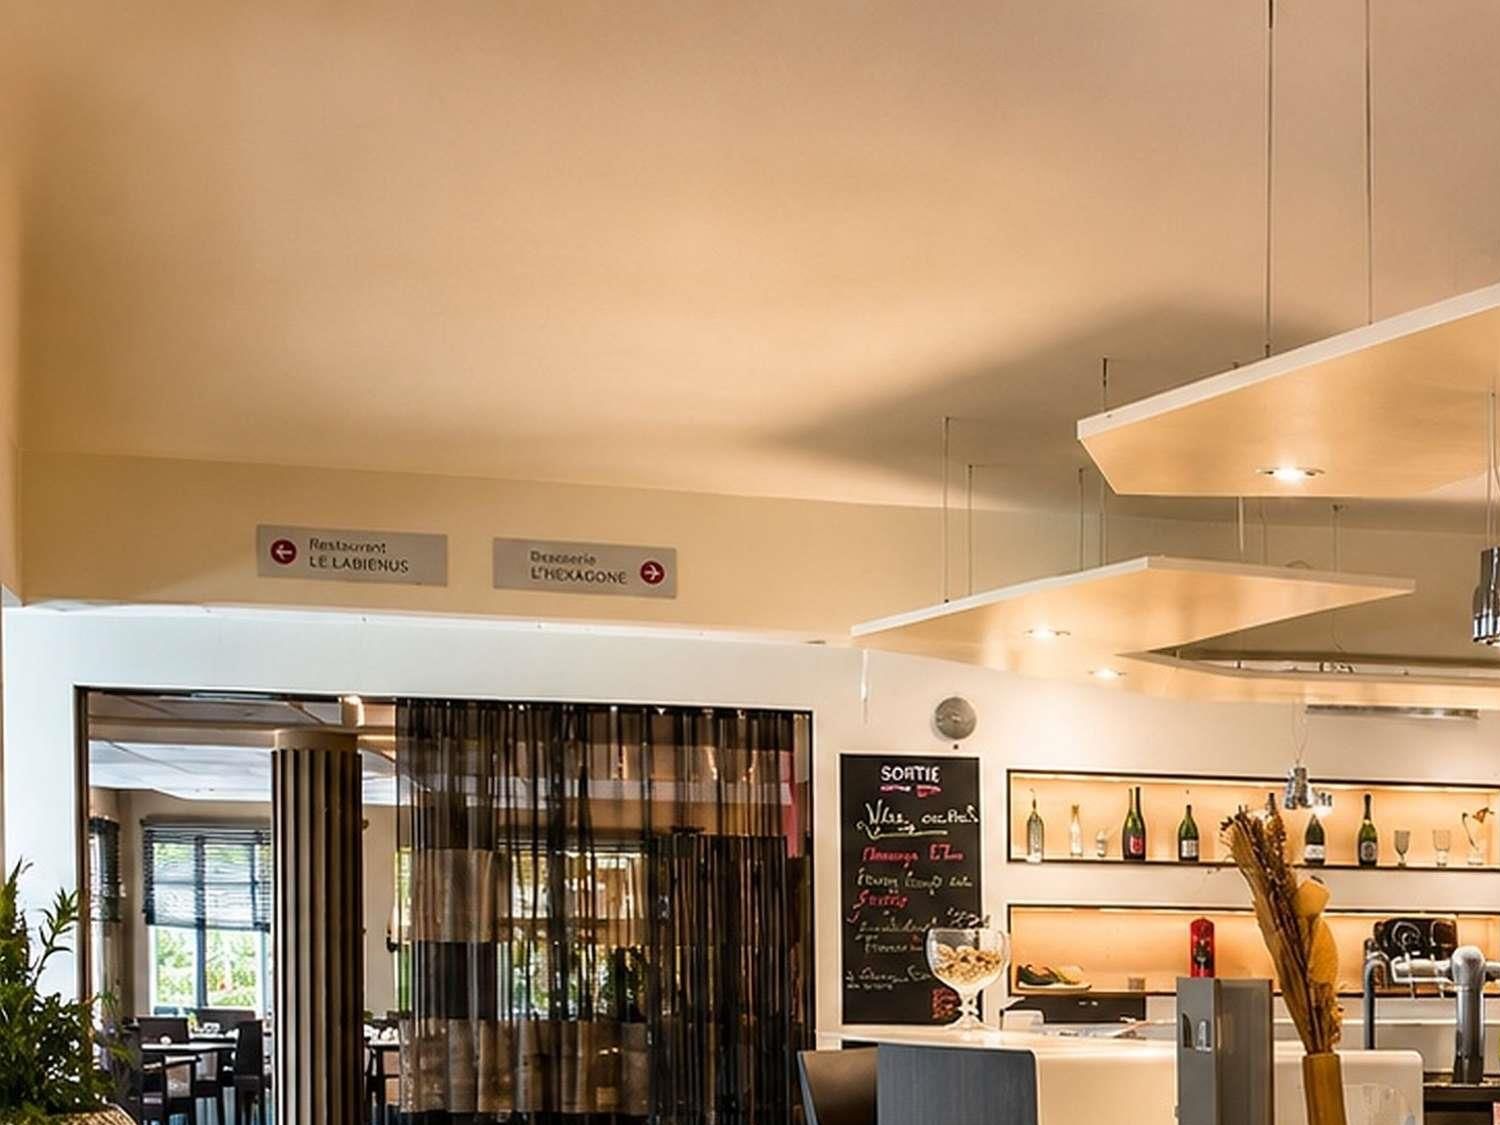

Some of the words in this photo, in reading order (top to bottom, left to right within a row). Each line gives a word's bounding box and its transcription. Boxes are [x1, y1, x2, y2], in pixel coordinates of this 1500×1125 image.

[309, 538, 386, 554] Restaurant
[309, 556, 327, 568] LE
[333, 557, 409, 573] LABIENUS
[531, 566, 628, 584] L'HEXAGONE
